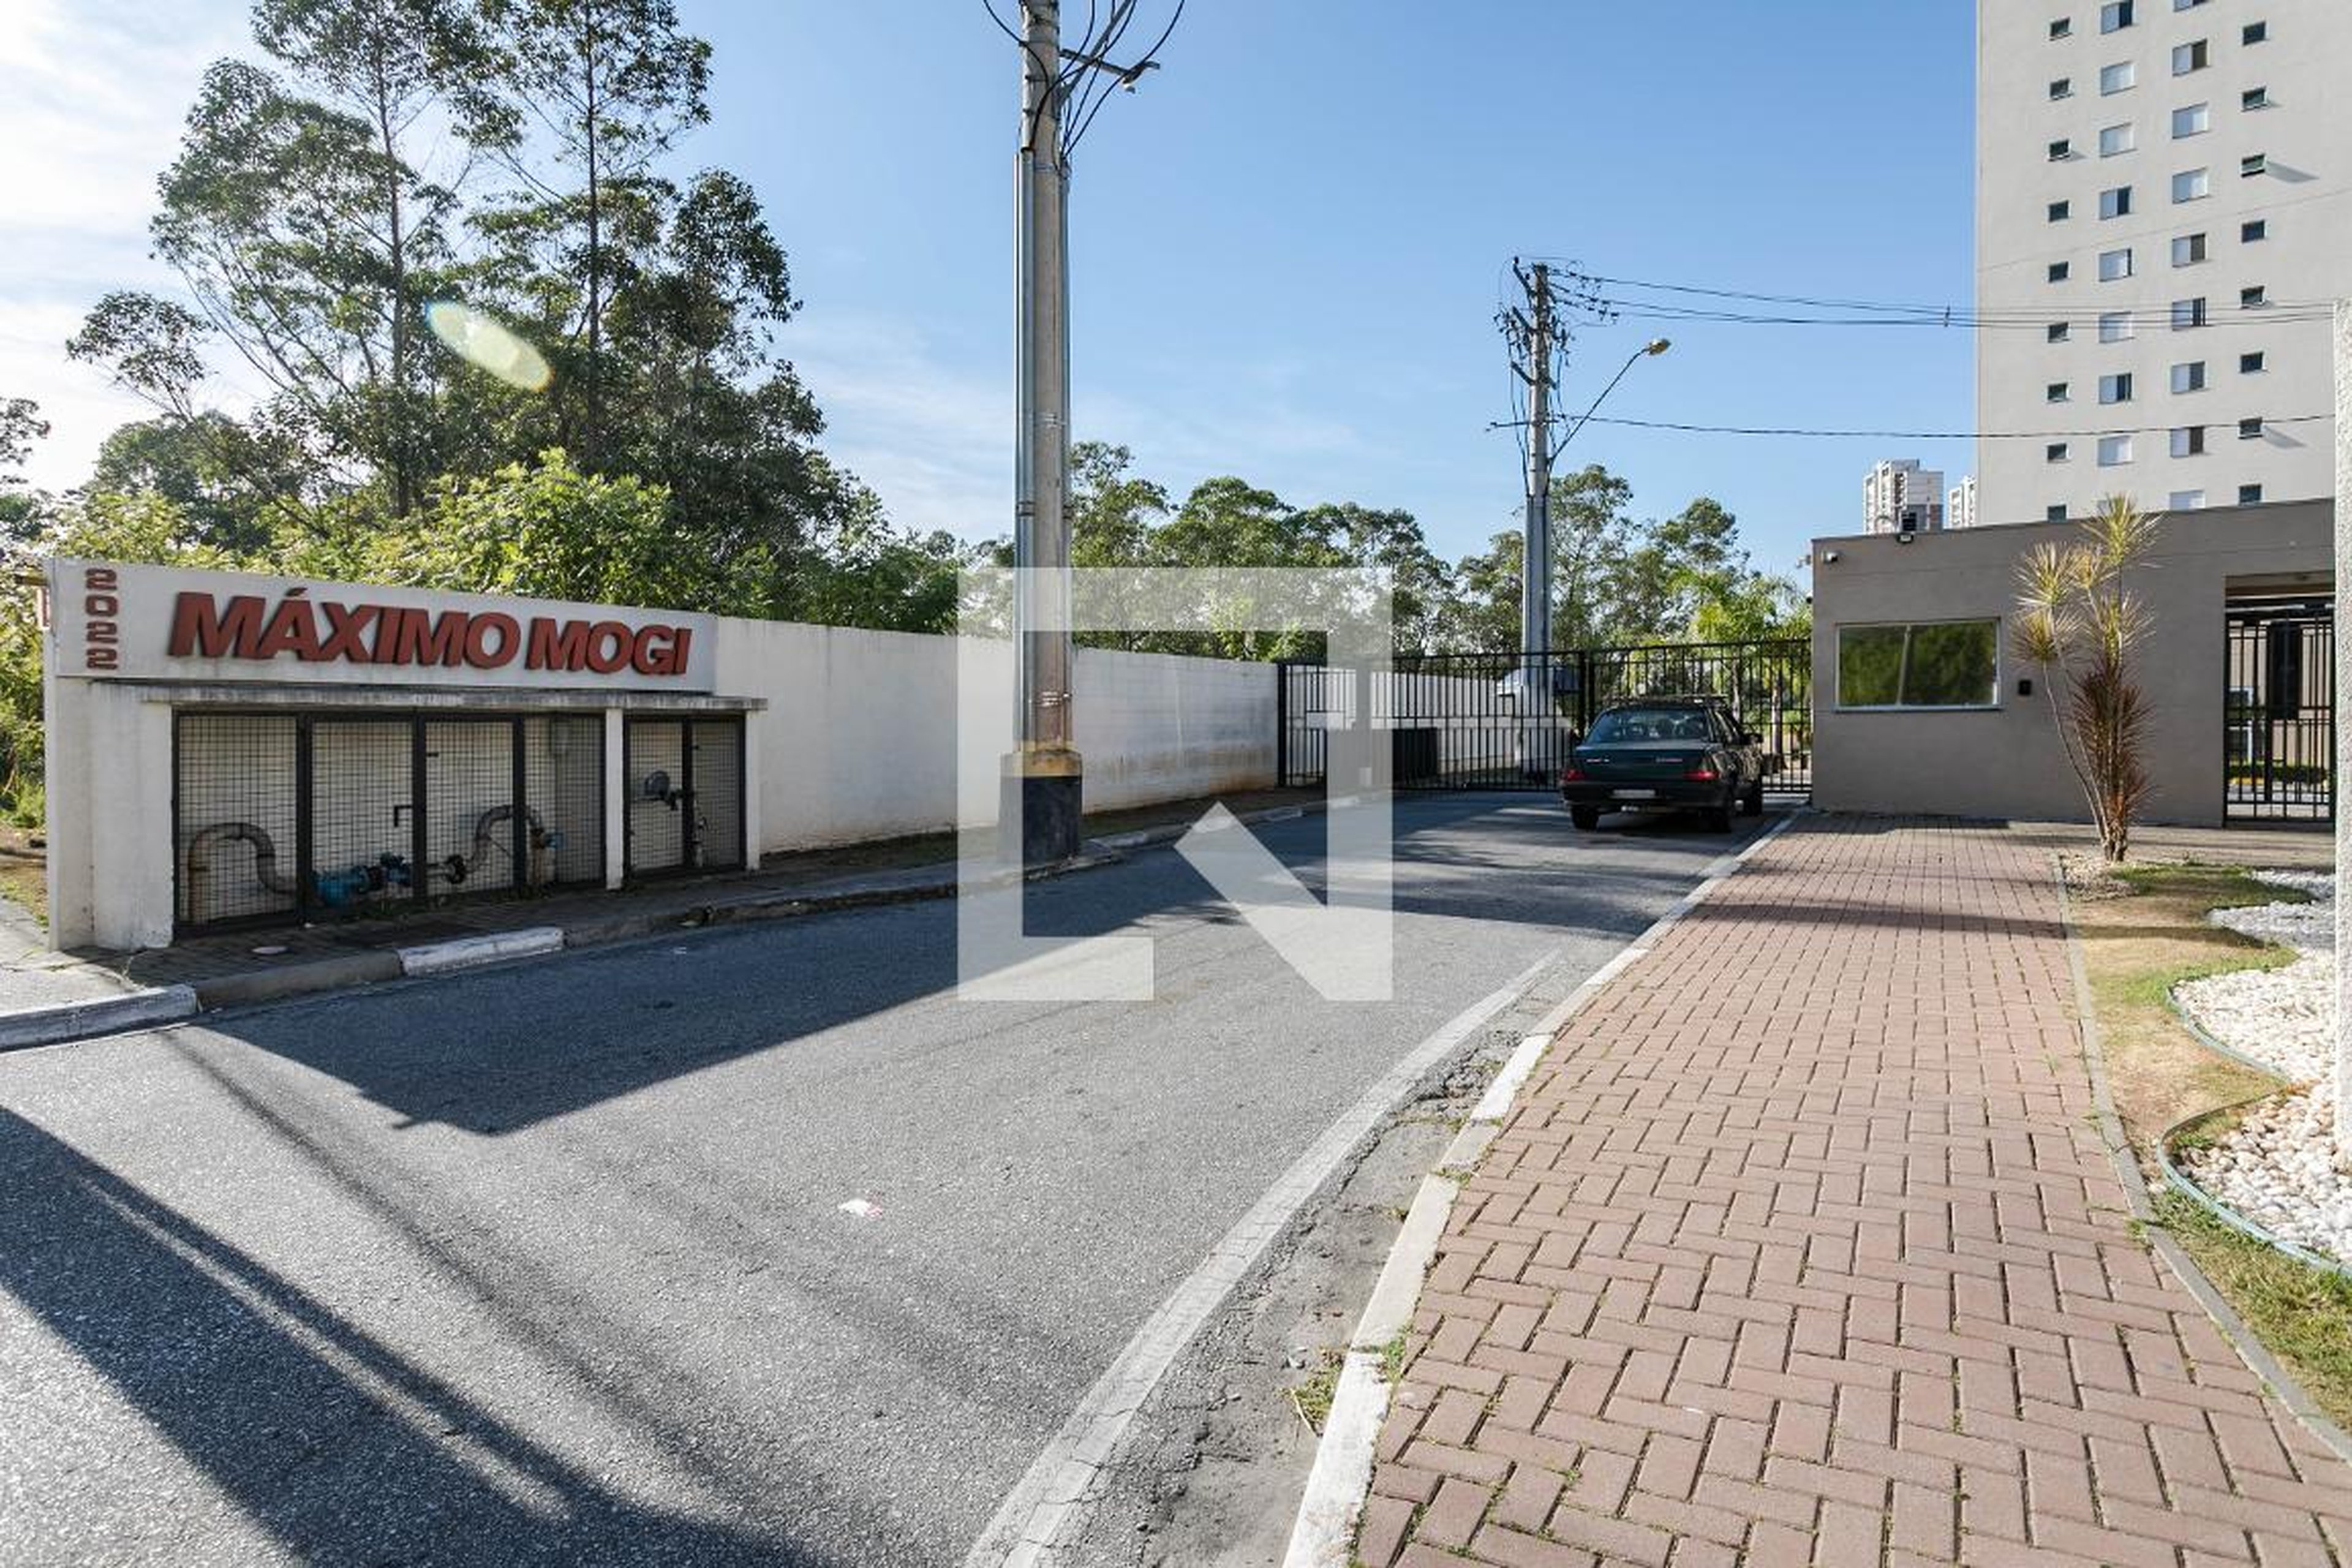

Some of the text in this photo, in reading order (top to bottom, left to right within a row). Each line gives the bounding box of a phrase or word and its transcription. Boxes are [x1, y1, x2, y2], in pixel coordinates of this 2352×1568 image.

[85, 568, 118, 670] 2022
[168, 587, 693, 674] MÁXIMO MOGI
